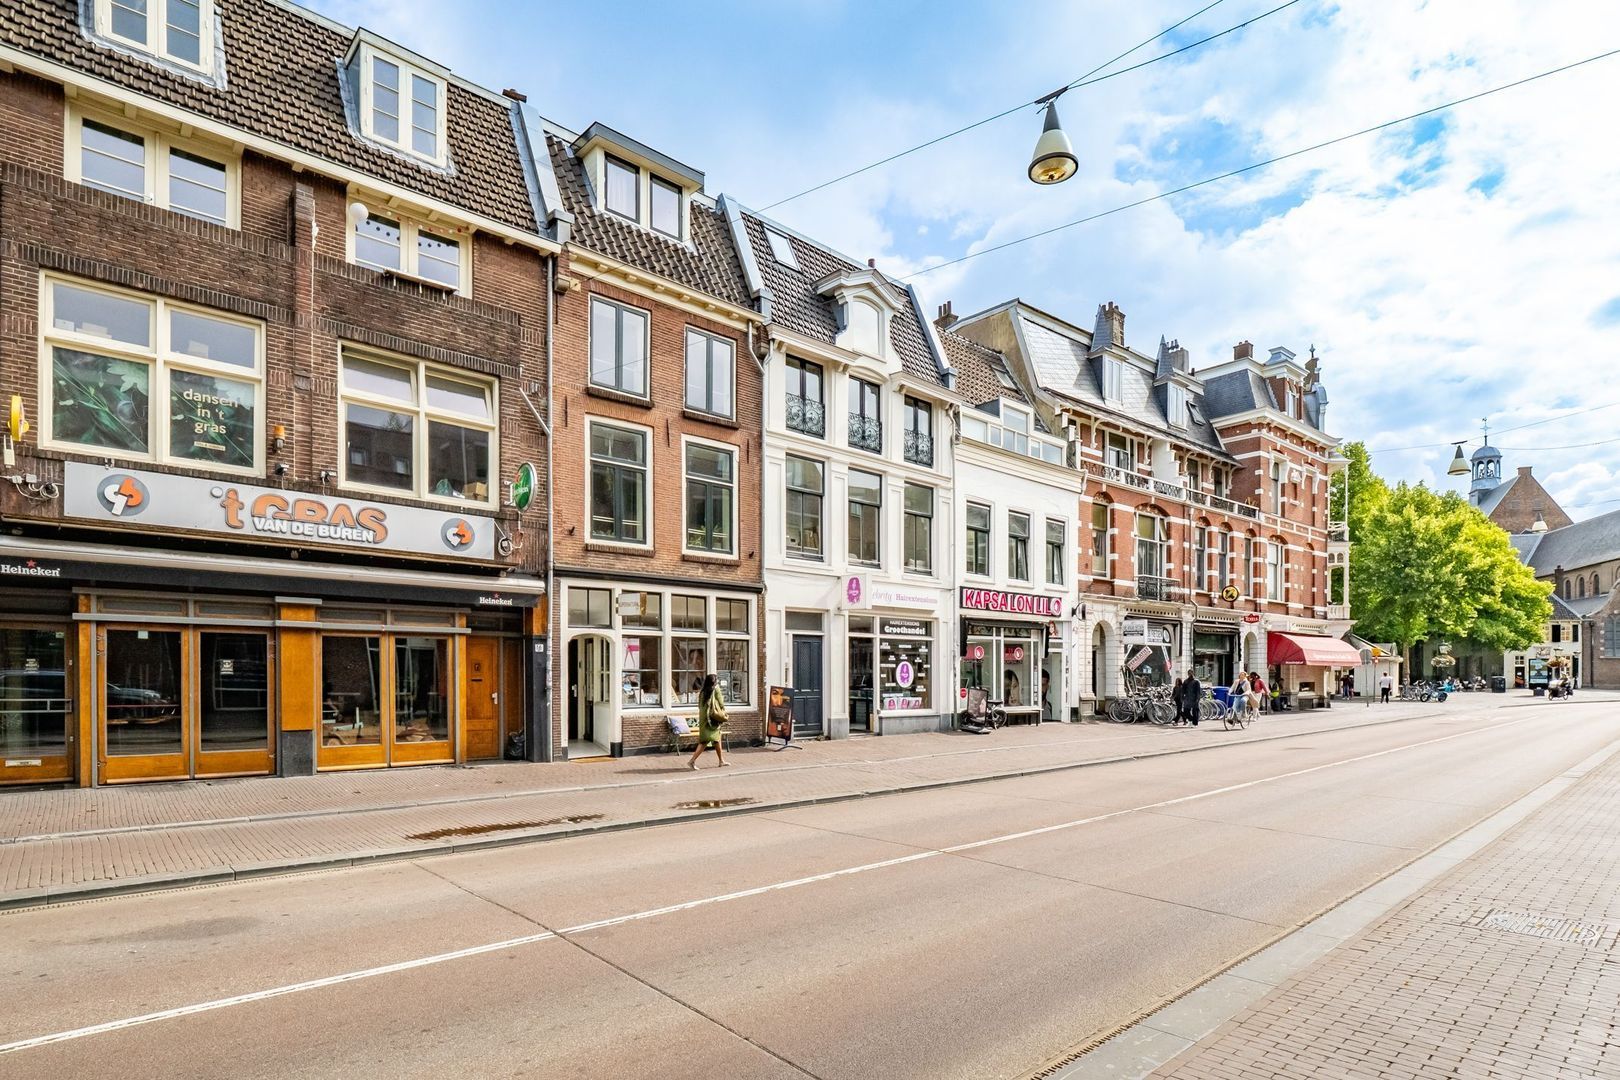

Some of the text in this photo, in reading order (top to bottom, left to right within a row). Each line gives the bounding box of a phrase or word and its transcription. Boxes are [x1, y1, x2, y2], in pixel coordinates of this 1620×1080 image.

[183, 388, 238, 408] dansen
[197, 402, 211, 418] in
[194, 421, 227, 434] gras
[251, 494, 388, 543] GRAS
[253, 517, 375, 544] VAN DE BUREN
[0, 564, 61, 577] Heineken
[479, 596, 513, 606] Heineken
[962, 588, 1034, 614] KAPSALON
[884, 625, 927, 636] Groothandel
